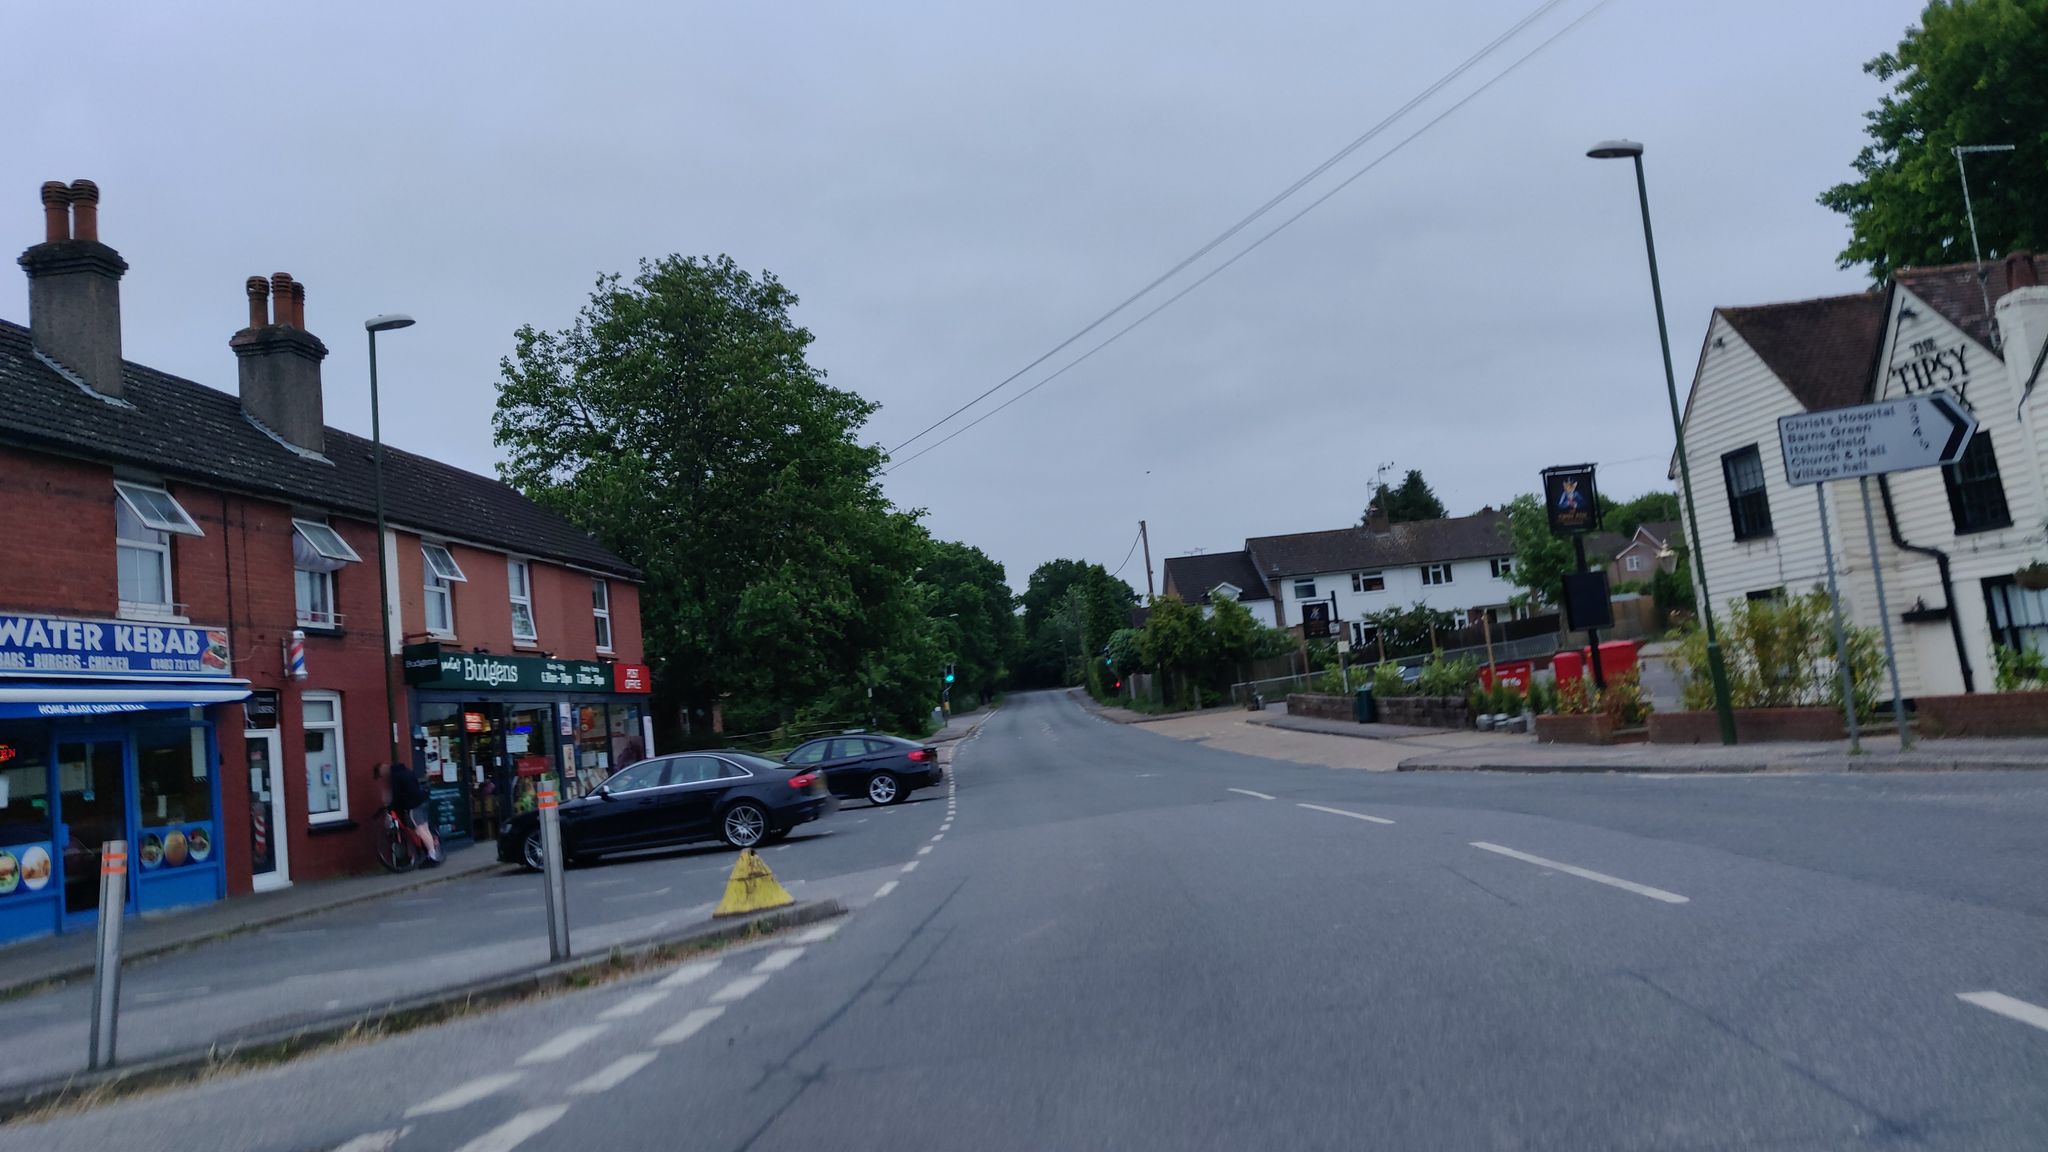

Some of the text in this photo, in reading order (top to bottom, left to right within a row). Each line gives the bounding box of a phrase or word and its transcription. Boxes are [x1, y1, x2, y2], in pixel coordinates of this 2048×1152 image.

[1910, 338, 1937, 357] THE
[1892, 345, 1968, 394] TIPSY
[1785, 417, 1833, 432] Christs
[1839, 405, 1895, 423] Hospital
[1787, 431, 1826, 443] Barns
[1831, 424, 1872, 438] Green
[1789, 436, 1866, 455] Itchingfield
[1791, 454, 1840, 468] Church
[1793, 466, 1838, 479] Village
[0, 617, 200, 655] WATER KEBAB
[34, 653, 82, 669] BURGERS
[88, 656, 130, 671] CHICKEN
[463, 658, 518, 686] Budgens
